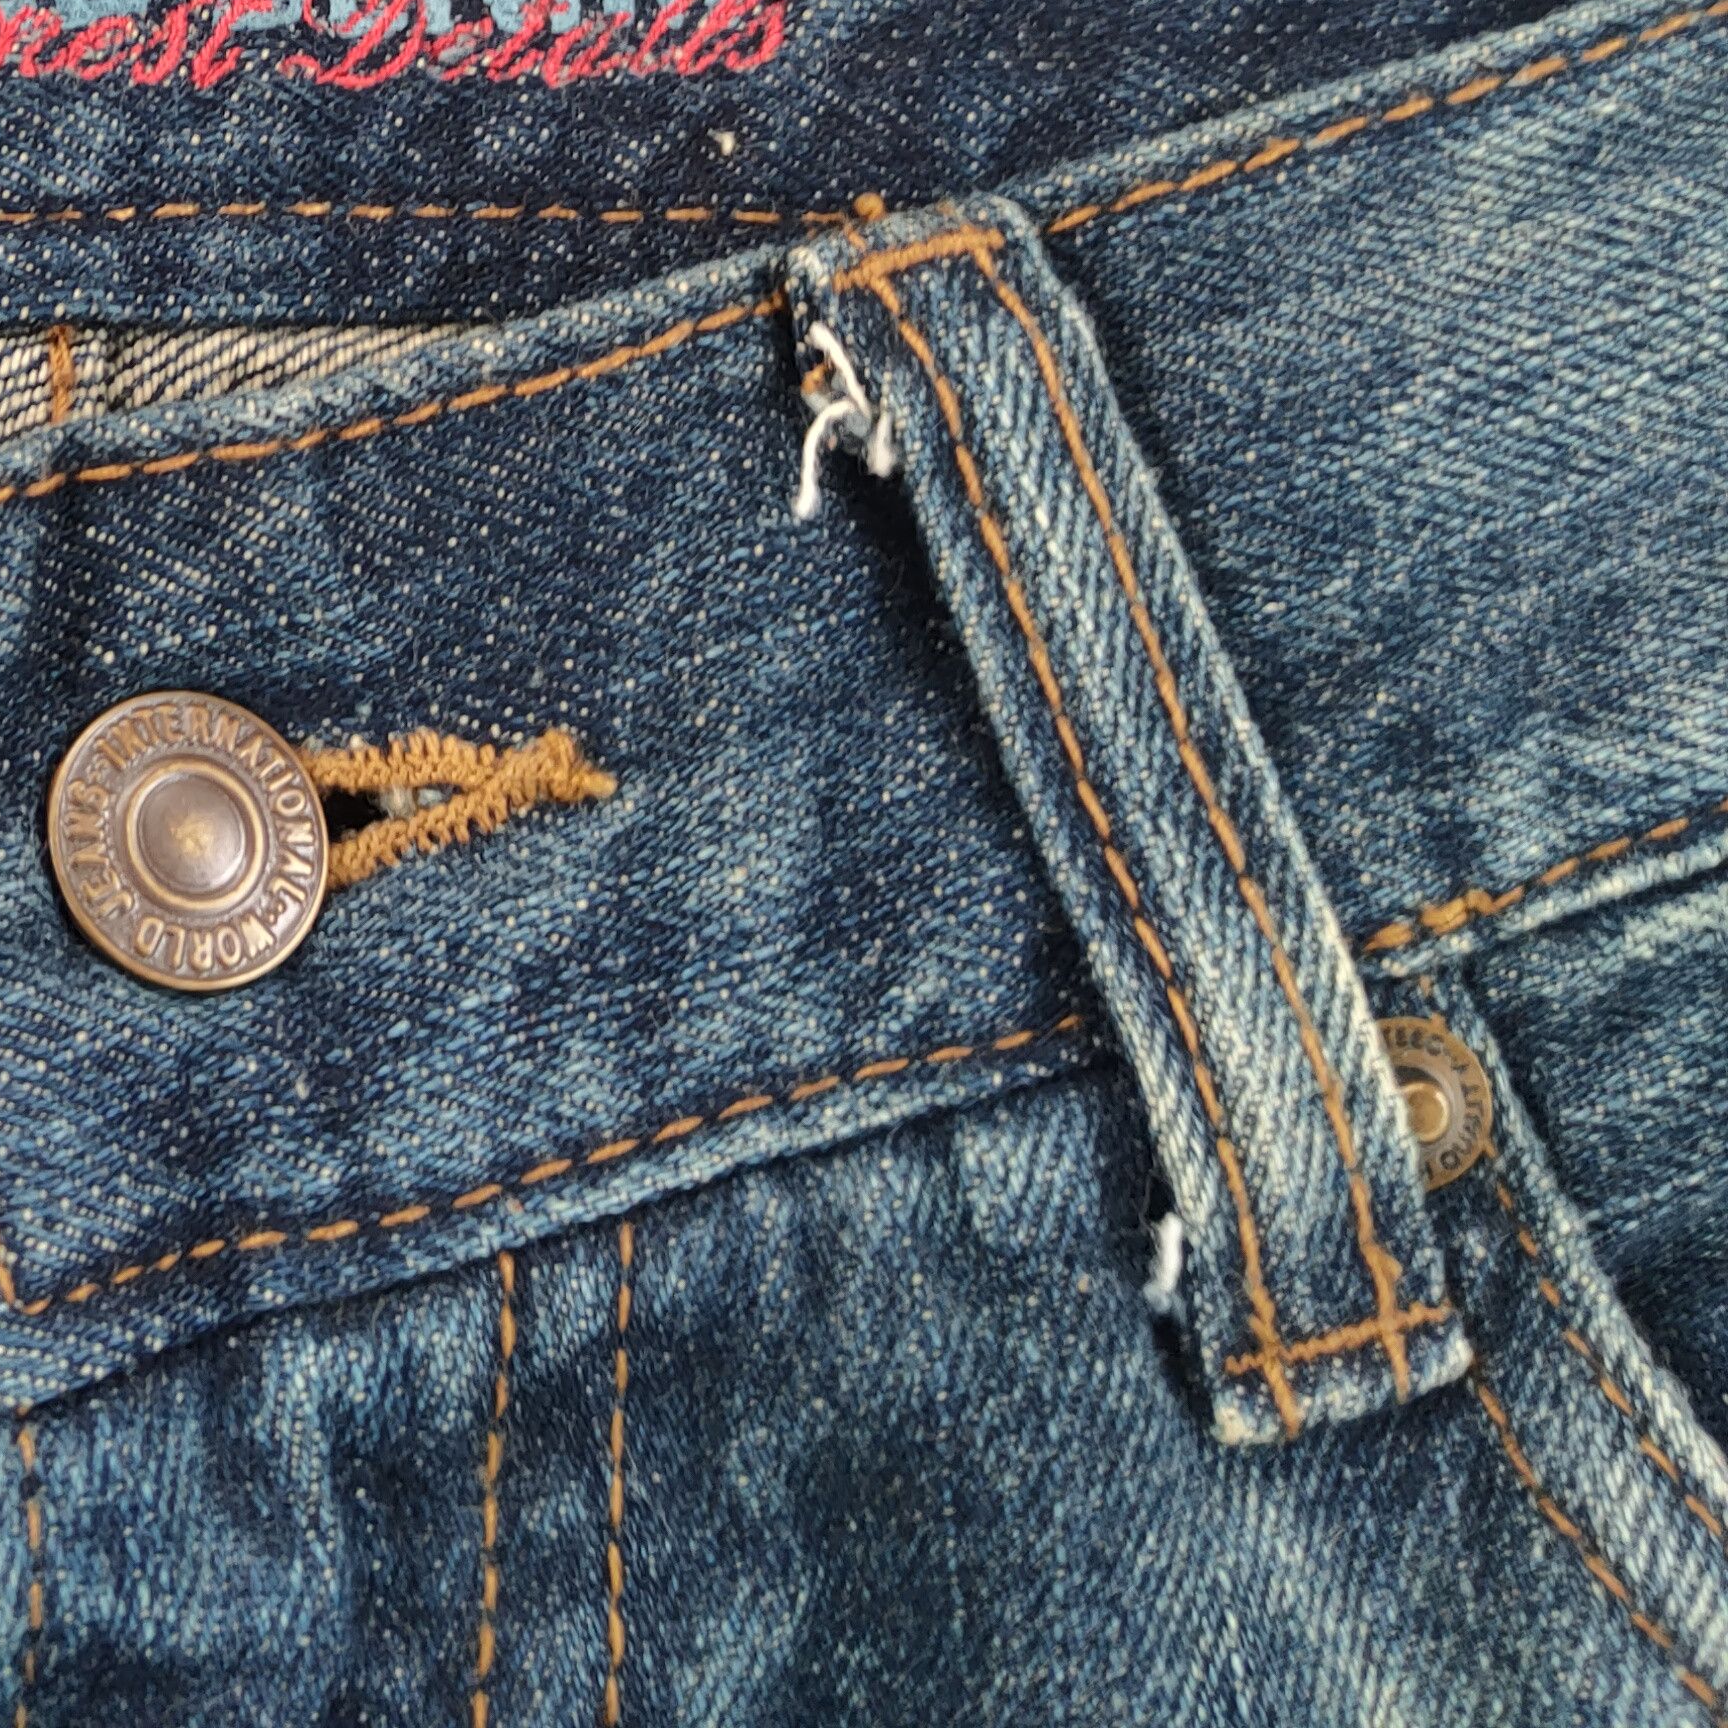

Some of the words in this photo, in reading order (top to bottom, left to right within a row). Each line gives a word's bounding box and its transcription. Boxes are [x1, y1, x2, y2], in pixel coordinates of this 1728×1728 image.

[62, 778, 134, 920] JEANS
[94, 703, 315, 905] INTERNATIONAL
[133, 912, 275, 971] WORLD
